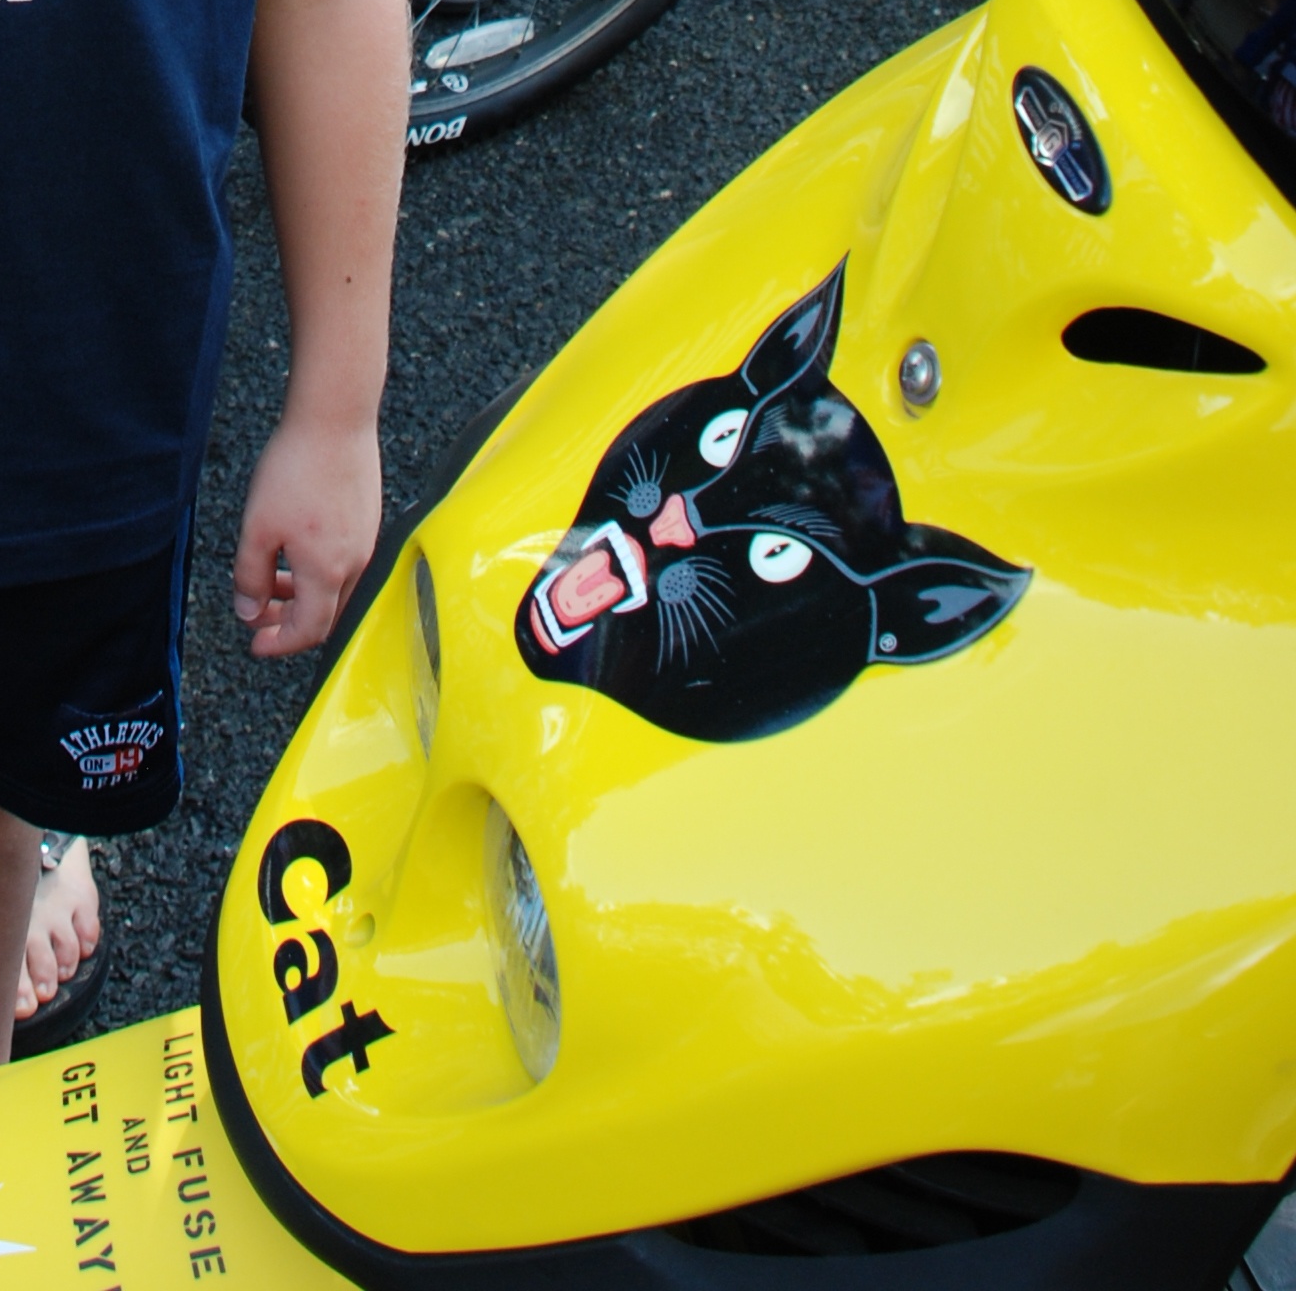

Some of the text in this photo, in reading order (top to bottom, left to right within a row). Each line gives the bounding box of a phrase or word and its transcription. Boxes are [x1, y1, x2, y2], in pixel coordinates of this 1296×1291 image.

[59, 719, 164, 761] ATHLETICS
[257, 818, 396, 1099] Cat
[62, 1061, 98, 1125] GET
[122, 1117, 151, 1175] AND
[163, 1032, 227, 1280] LIGHT FUSE
